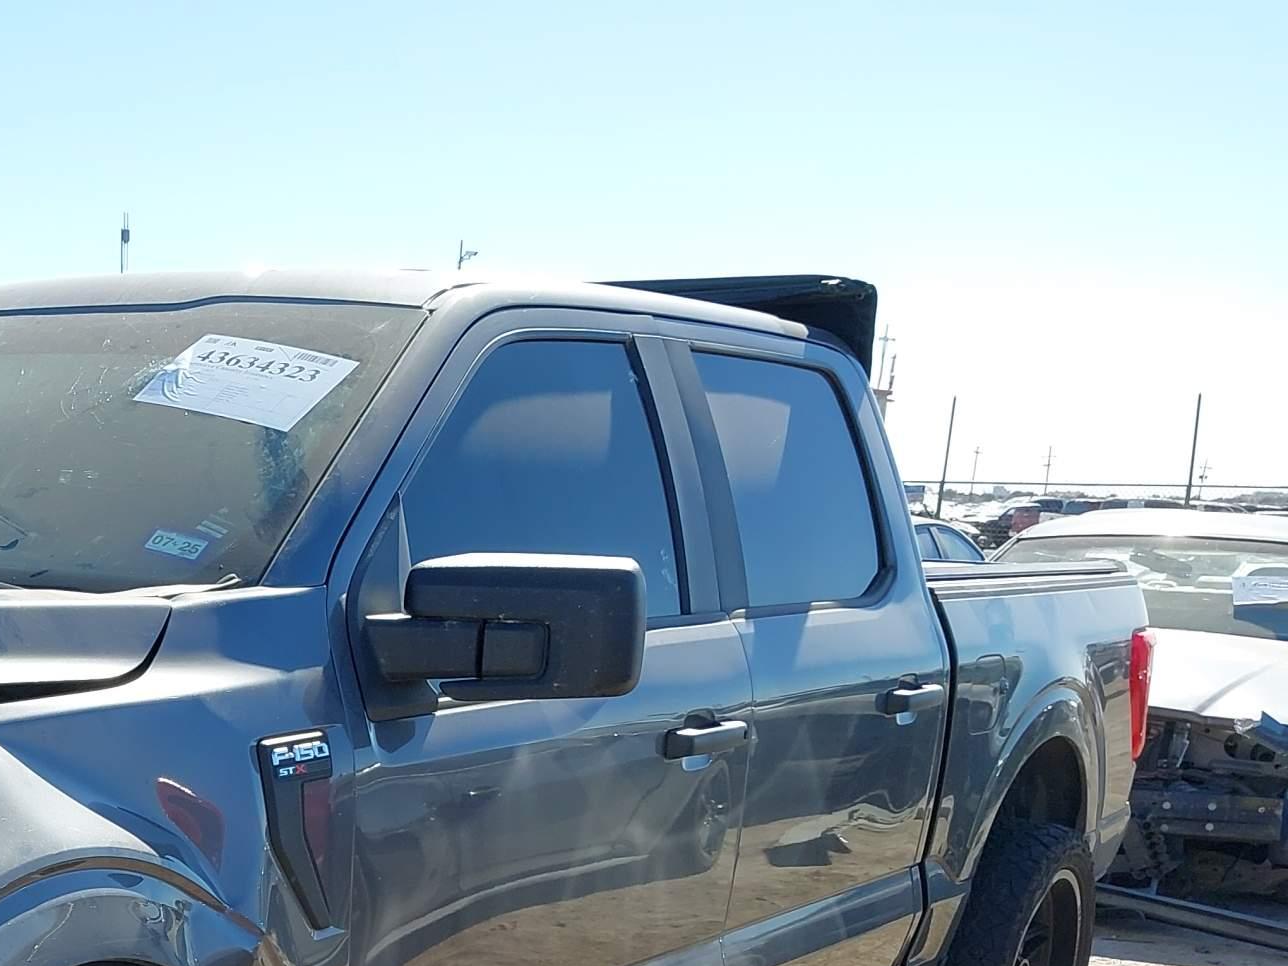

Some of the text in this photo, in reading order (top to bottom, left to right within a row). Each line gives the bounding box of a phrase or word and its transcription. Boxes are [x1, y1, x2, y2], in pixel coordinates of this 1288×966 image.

[196, 349, 321, 383] 43634323
[271, 740, 330, 766] F-150
[279, 764, 308, 777] STX
